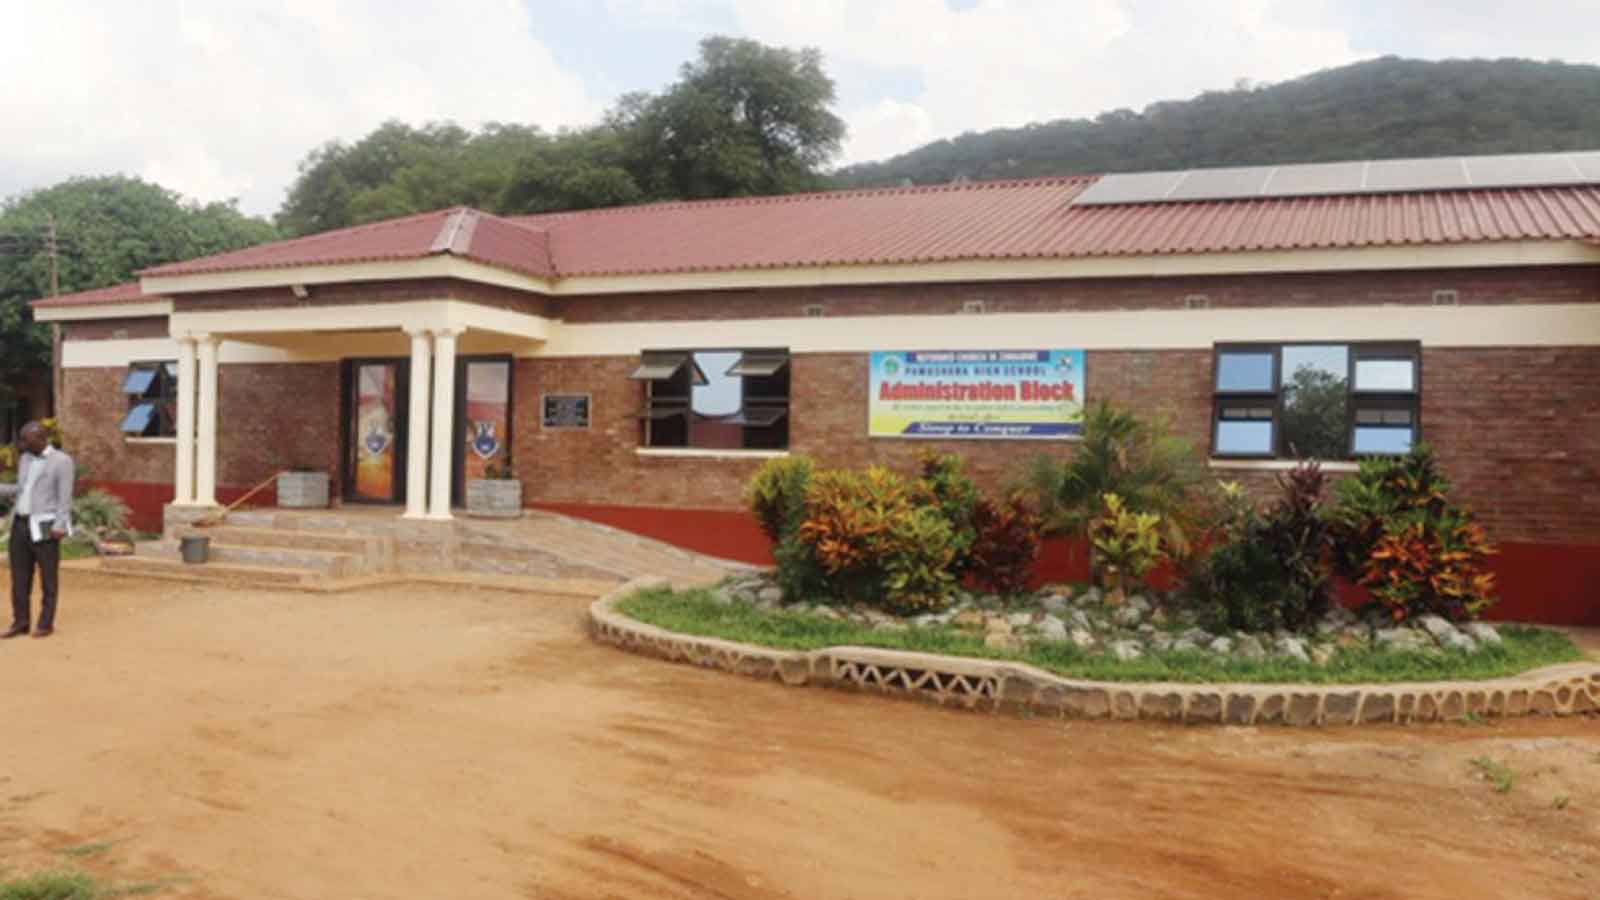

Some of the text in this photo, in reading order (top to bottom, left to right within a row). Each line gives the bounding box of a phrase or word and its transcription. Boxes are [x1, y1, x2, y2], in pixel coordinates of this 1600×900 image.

[974, 365, 998, 376] HIGH
[1003, 365, 1047, 376] SCHOOL
[879, 380, 1074, 401] Administration Block
